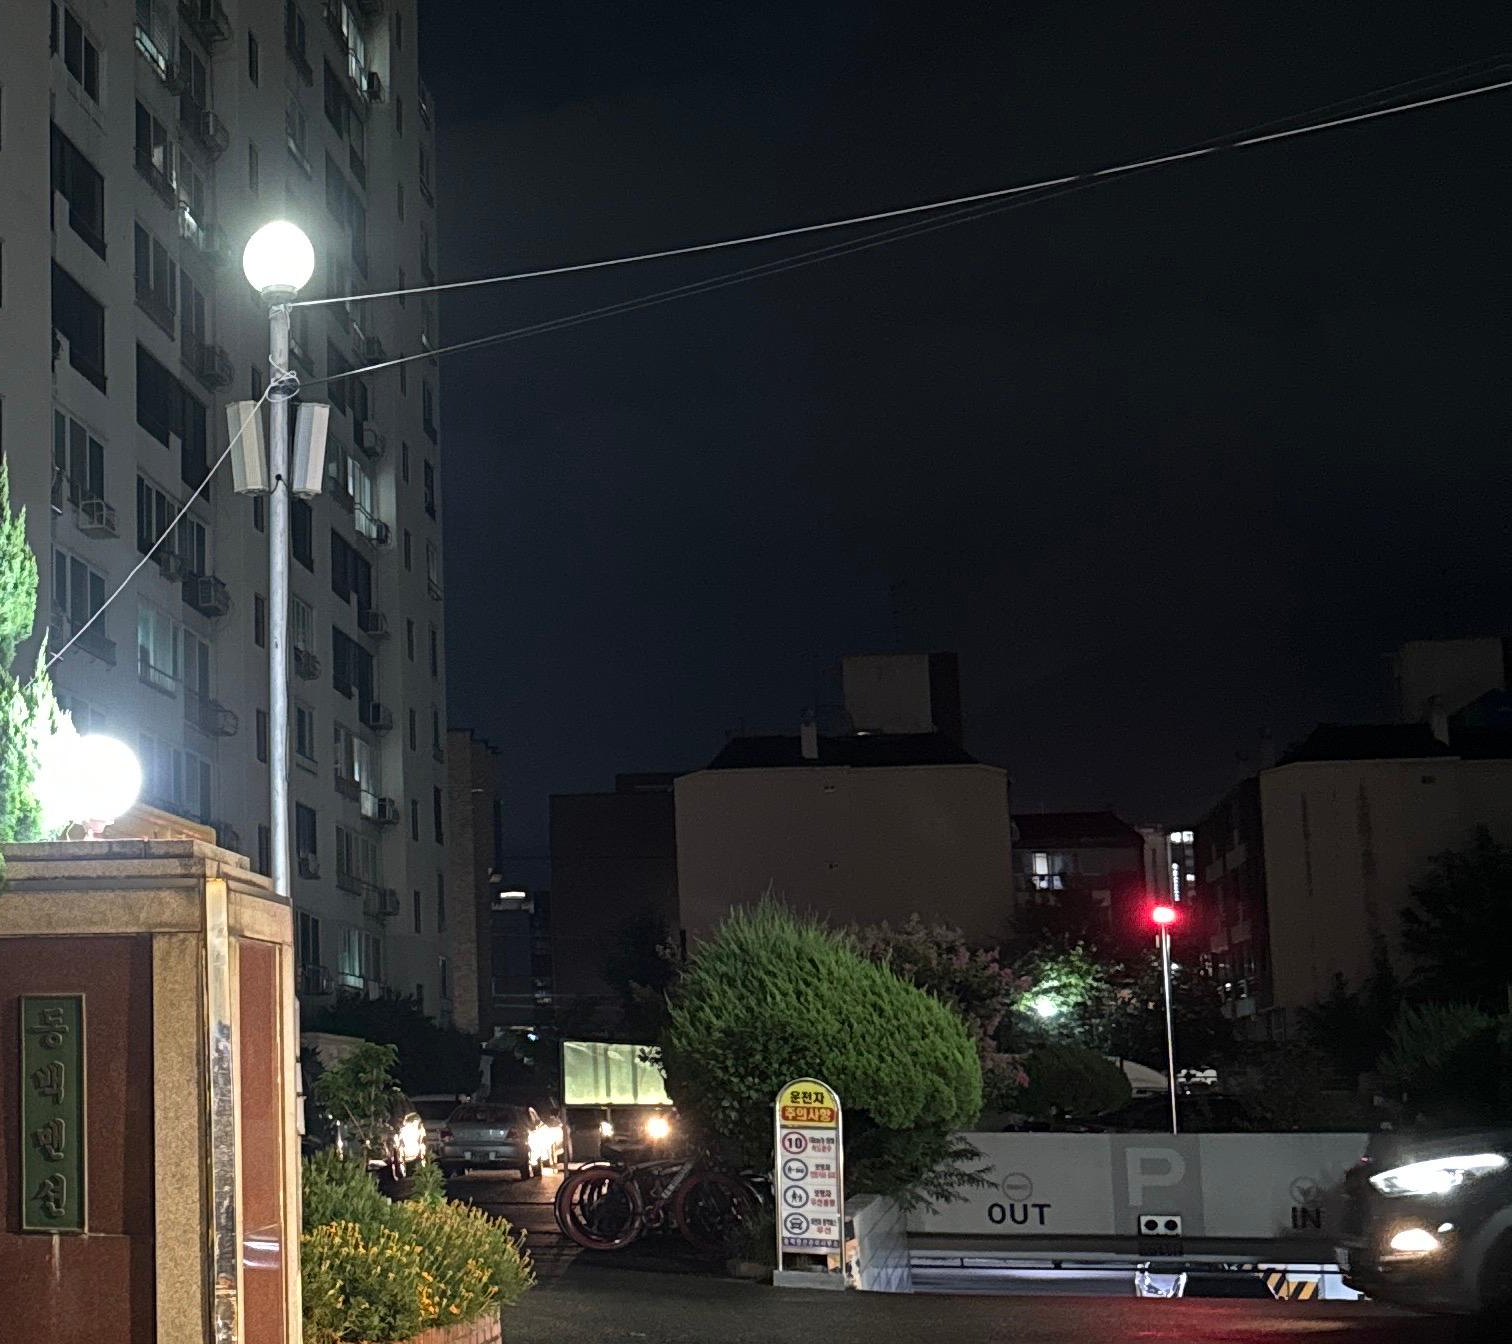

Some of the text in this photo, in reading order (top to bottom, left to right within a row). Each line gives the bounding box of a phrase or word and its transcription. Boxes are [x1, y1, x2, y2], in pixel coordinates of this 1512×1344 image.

[790, 1091, 824, 1104] 운전자
[785, 1107, 832, 1121] 주의사항
[787, 1138, 802, 1149] 10
[1126, 1147, 1186, 1206] P
[987, 1202, 1051, 1225] OUT
[1291, 1207, 1321, 1229] IN
